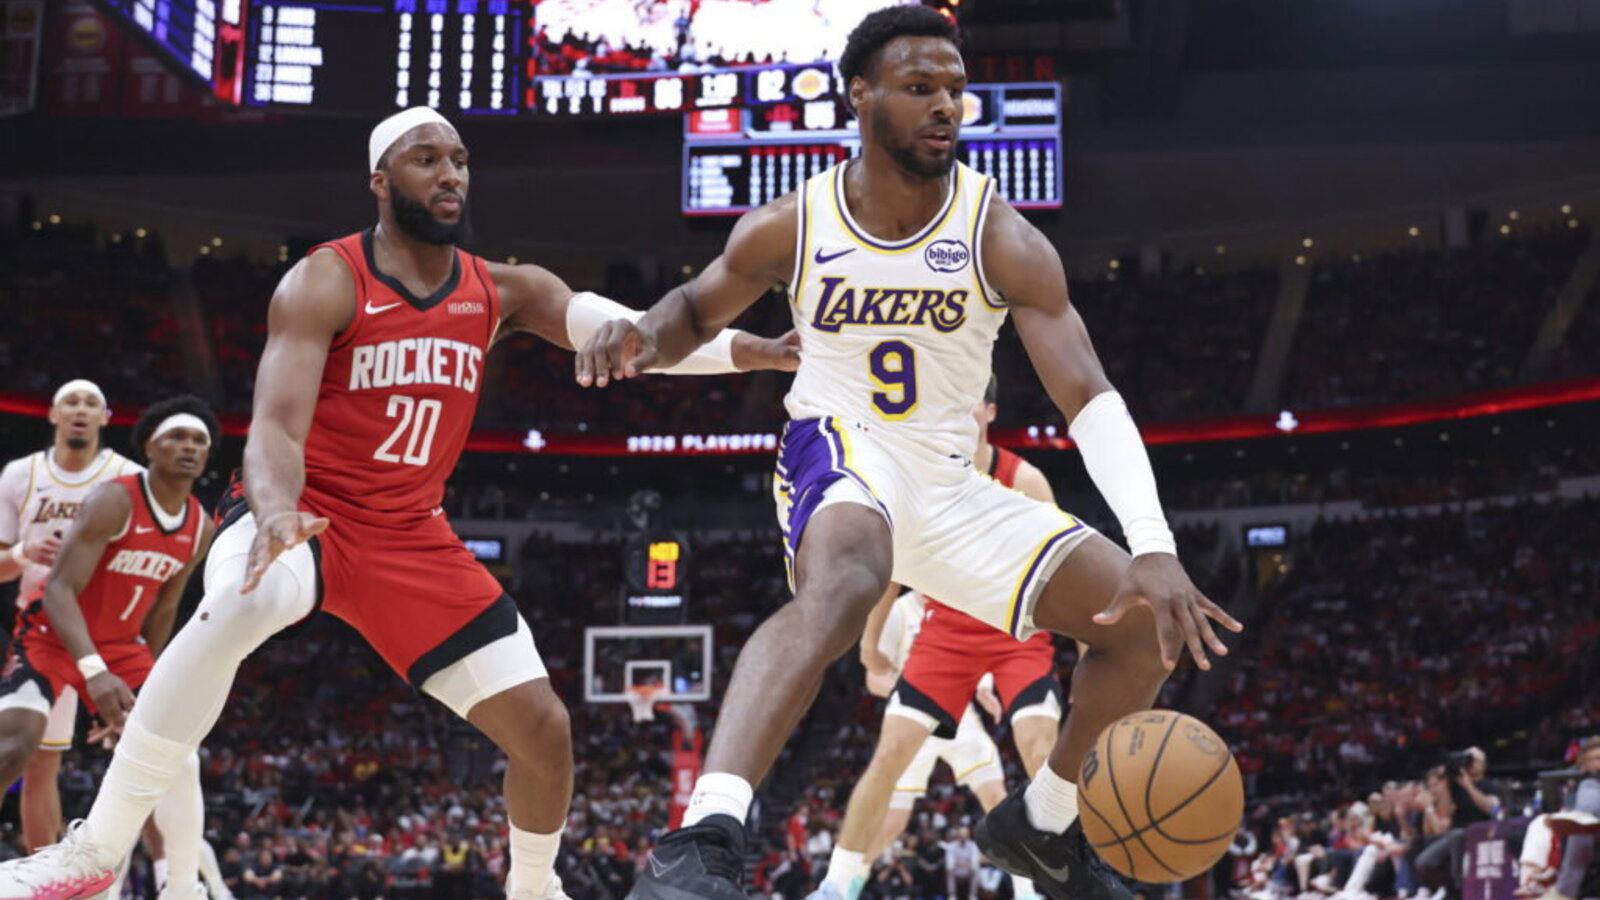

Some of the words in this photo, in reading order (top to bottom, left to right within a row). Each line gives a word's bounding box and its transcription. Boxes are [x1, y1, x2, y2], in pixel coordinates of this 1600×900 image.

[929, 248, 967, 264] bibigo
[811, 276, 970, 334] LAKERS
[349, 337, 483, 393] ROCKETS
[868, 339, 919, 421] 9
[373, 395, 442, 466] 20
[682, 434, 777, 451] PLAYOFFS
[31, 498, 84, 524] LAKE
[106, 548, 185, 584] ROCKET
[119, 585, 144, 621] 1
